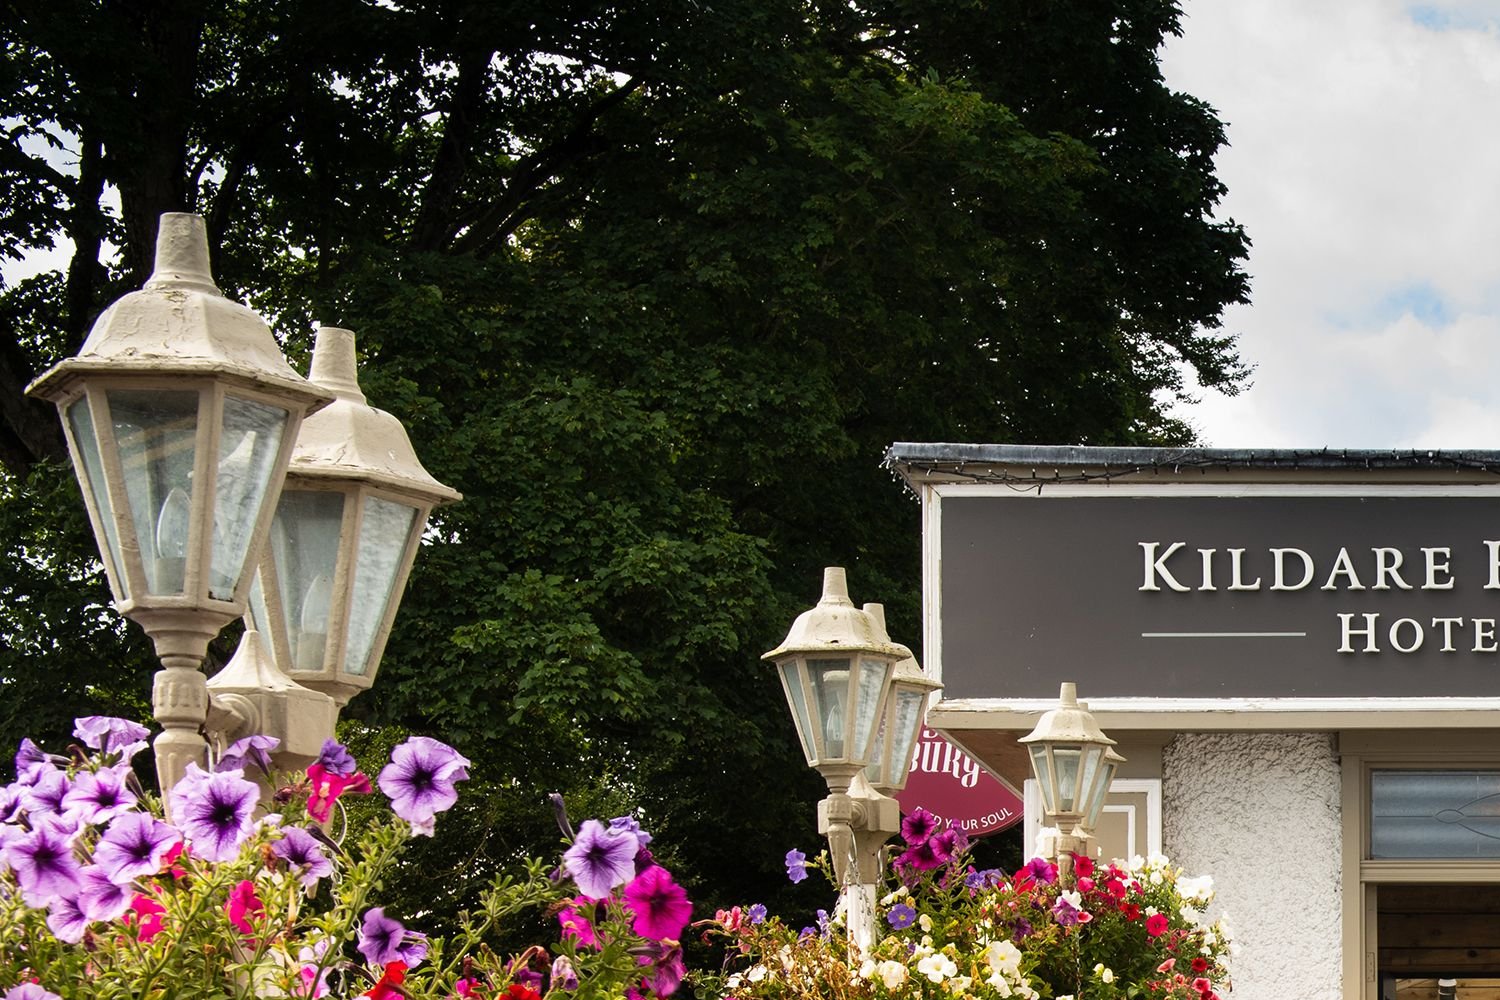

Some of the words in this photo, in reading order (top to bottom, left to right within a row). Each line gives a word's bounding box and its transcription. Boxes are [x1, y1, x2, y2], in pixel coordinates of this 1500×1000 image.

[1138, 541, 1455, 592] KILDARE
[945, 818, 979, 831] YUR
[980, 807, 1013, 827] SOUL
